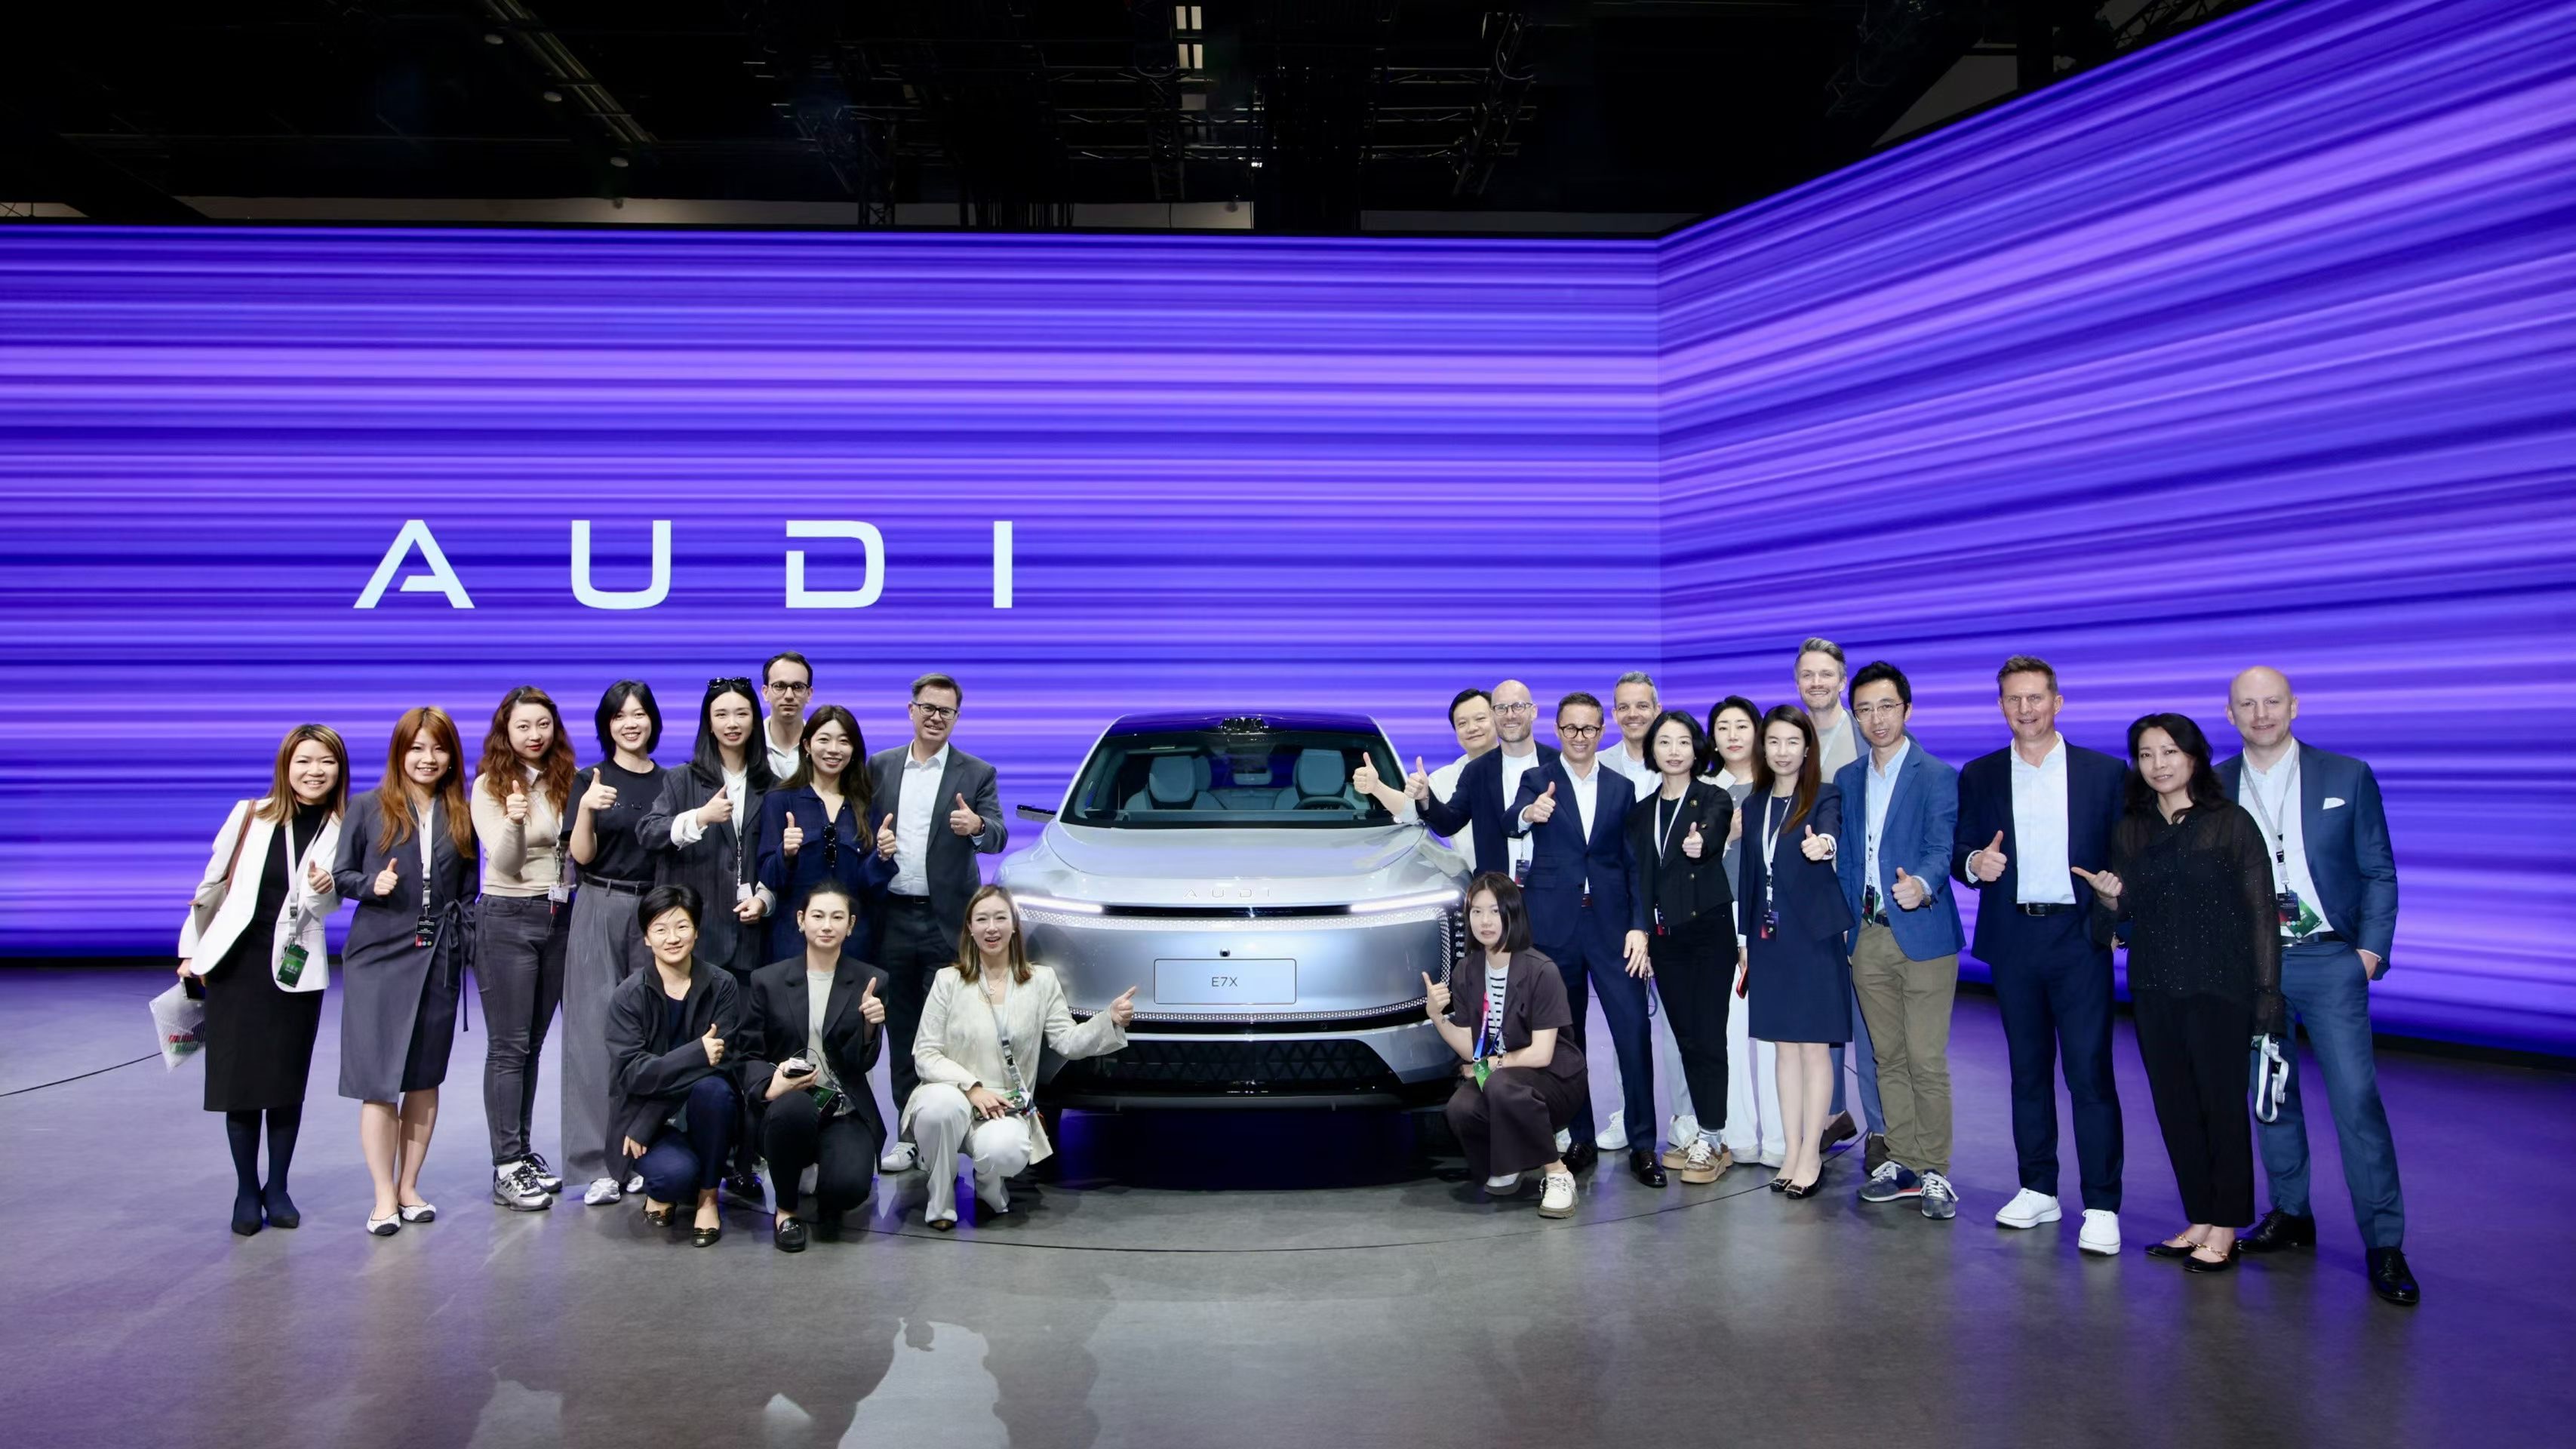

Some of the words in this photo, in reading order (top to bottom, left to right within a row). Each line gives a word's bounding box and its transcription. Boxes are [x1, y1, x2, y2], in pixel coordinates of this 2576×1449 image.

[352, 519, 1013, 610] AUDI
[1183, 888, 1271, 898] AUDI
[1212, 977, 1238, 987] E7X
